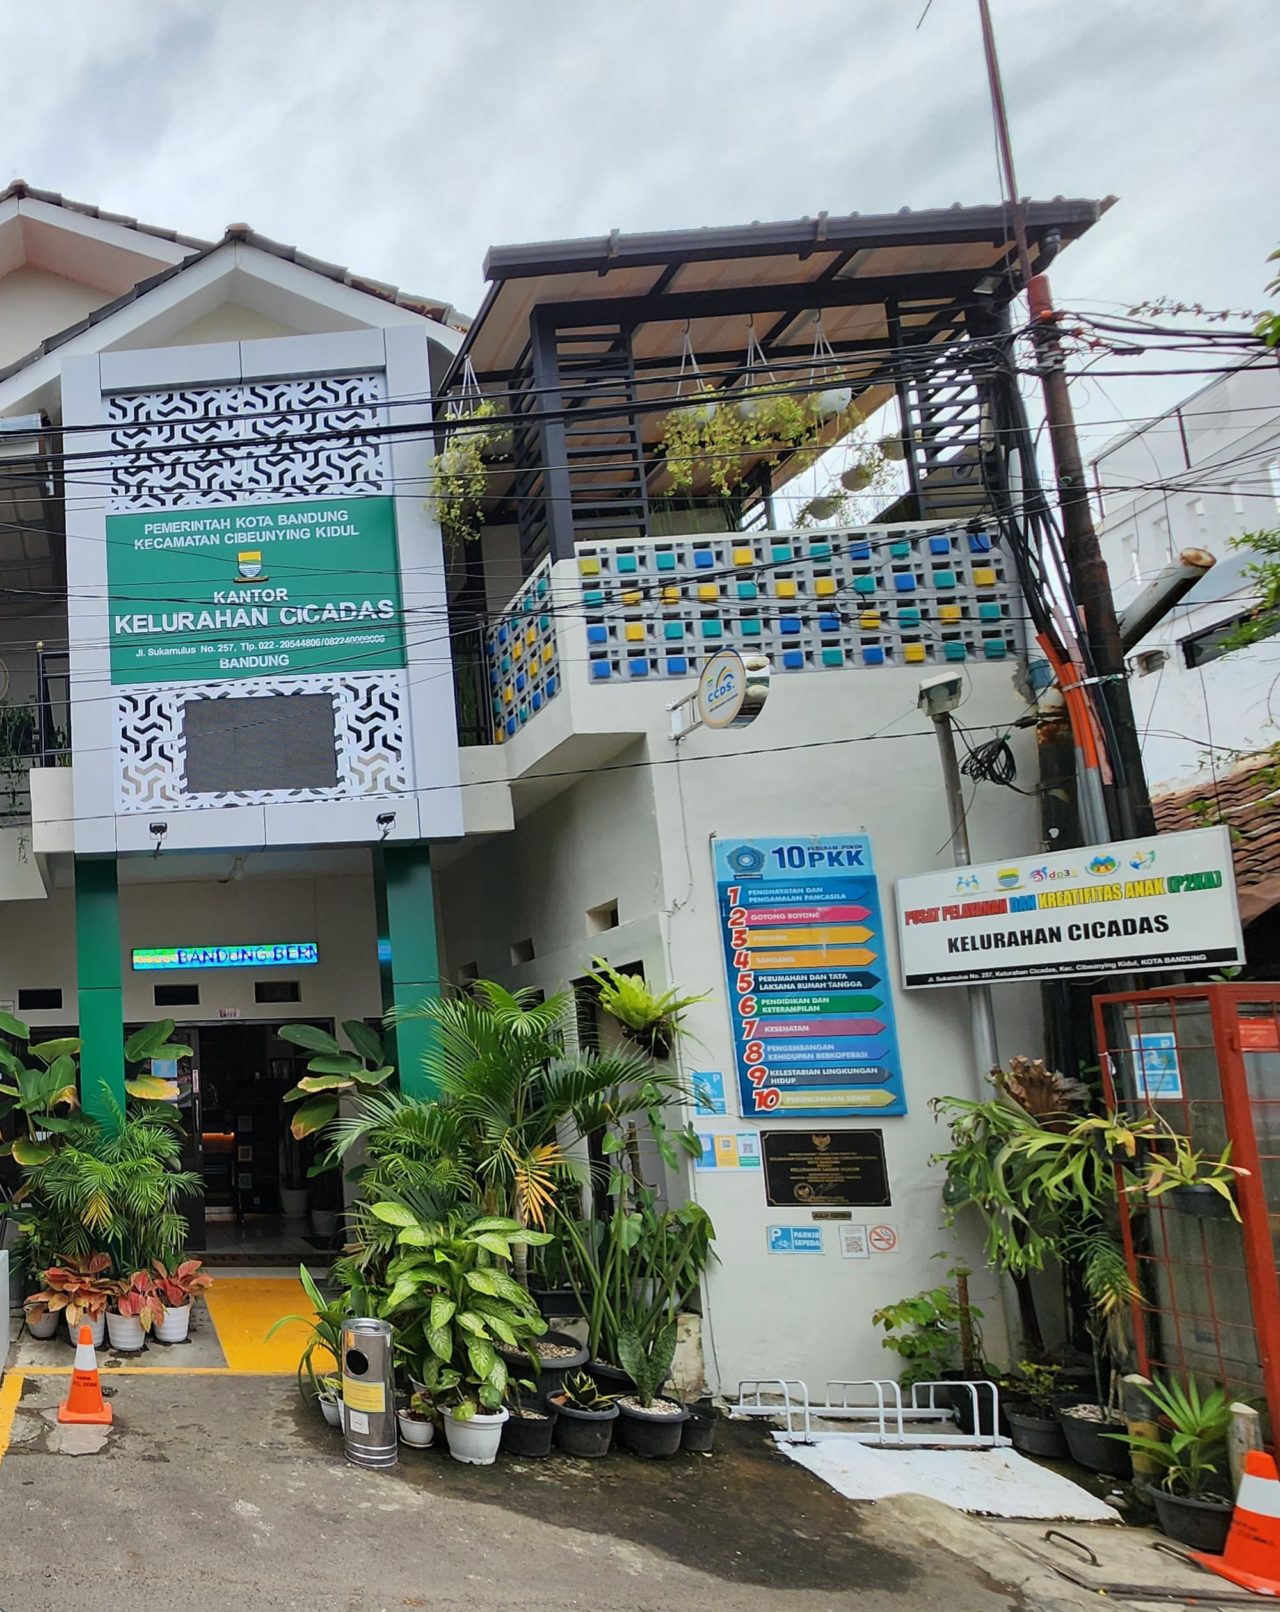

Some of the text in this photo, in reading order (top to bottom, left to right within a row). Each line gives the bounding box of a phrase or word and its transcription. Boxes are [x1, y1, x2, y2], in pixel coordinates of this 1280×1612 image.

[144, 510, 348, 534] PEMERINTAH KOTA BANDUNG
[134, 525, 359, 550] KECAMATAN CIBEUNYING KIDUL
[213, 587, 288, 604] KANTOR
[115, 599, 395, 634] KELURAHAN CICADAS
[136, 648, 146, 657] Jl.
[148, 646, 197, 656] Sukamulus
[240, 642, 258, 652] Tlp.
[220, 654, 289, 669] BANDUNG
[772, 846, 864, 868] 10 PKK
[728, 887, 741, 905] 1
[748, 888, 804, 896] PENGHAYATAN
[749, 895, 803, 903] PENGAMALAN
[904, 870, 1222, 926] PUSAT PELAYANAN DAN KREATIFITAS ANAK (P2KA)
[729, 908, 747, 927] 2
[751, 913, 785, 921] GOTONG
[732, 928, 749, 949] 3
[948, 914, 1169, 953] KELURAHAN CICADAS
[177, 948, 267, 964] BANDUNG
[734, 950, 751, 969] 4
[1117, 959, 1139, 968] Kidul,
[1140, 958, 1164, 966] KOTA
[1164, 954, 1207, 964] BANDUNG
[737, 972, 754, 994] 5
[758, 974, 808, 982] PERUMAHAN
[759, 983, 796, 991] LAKSANA
[826, 980, 862, 988] TANGGA
[738, 995, 757, 1016] 6
[761, 997, 810, 1005] PENDIDIKAN
[762, 1005, 820, 1013] KETERAMPILAN
[742, 1018, 759, 1040] 7
[744, 1041, 764, 1064] 8
[767, 1043, 834, 1051] PENGEMBANGAN
[768, 1053, 815, 1061] KEHIDUPAN
[747, 1065, 768, 1087] 9
[770, 1067, 878, 1076] KELESTARIAN LINGKUNGAN
[771, 1077, 796, 1085] HIDUP
[753, 1088, 781, 1111] 10
[771, 1228, 782, 1242] P
